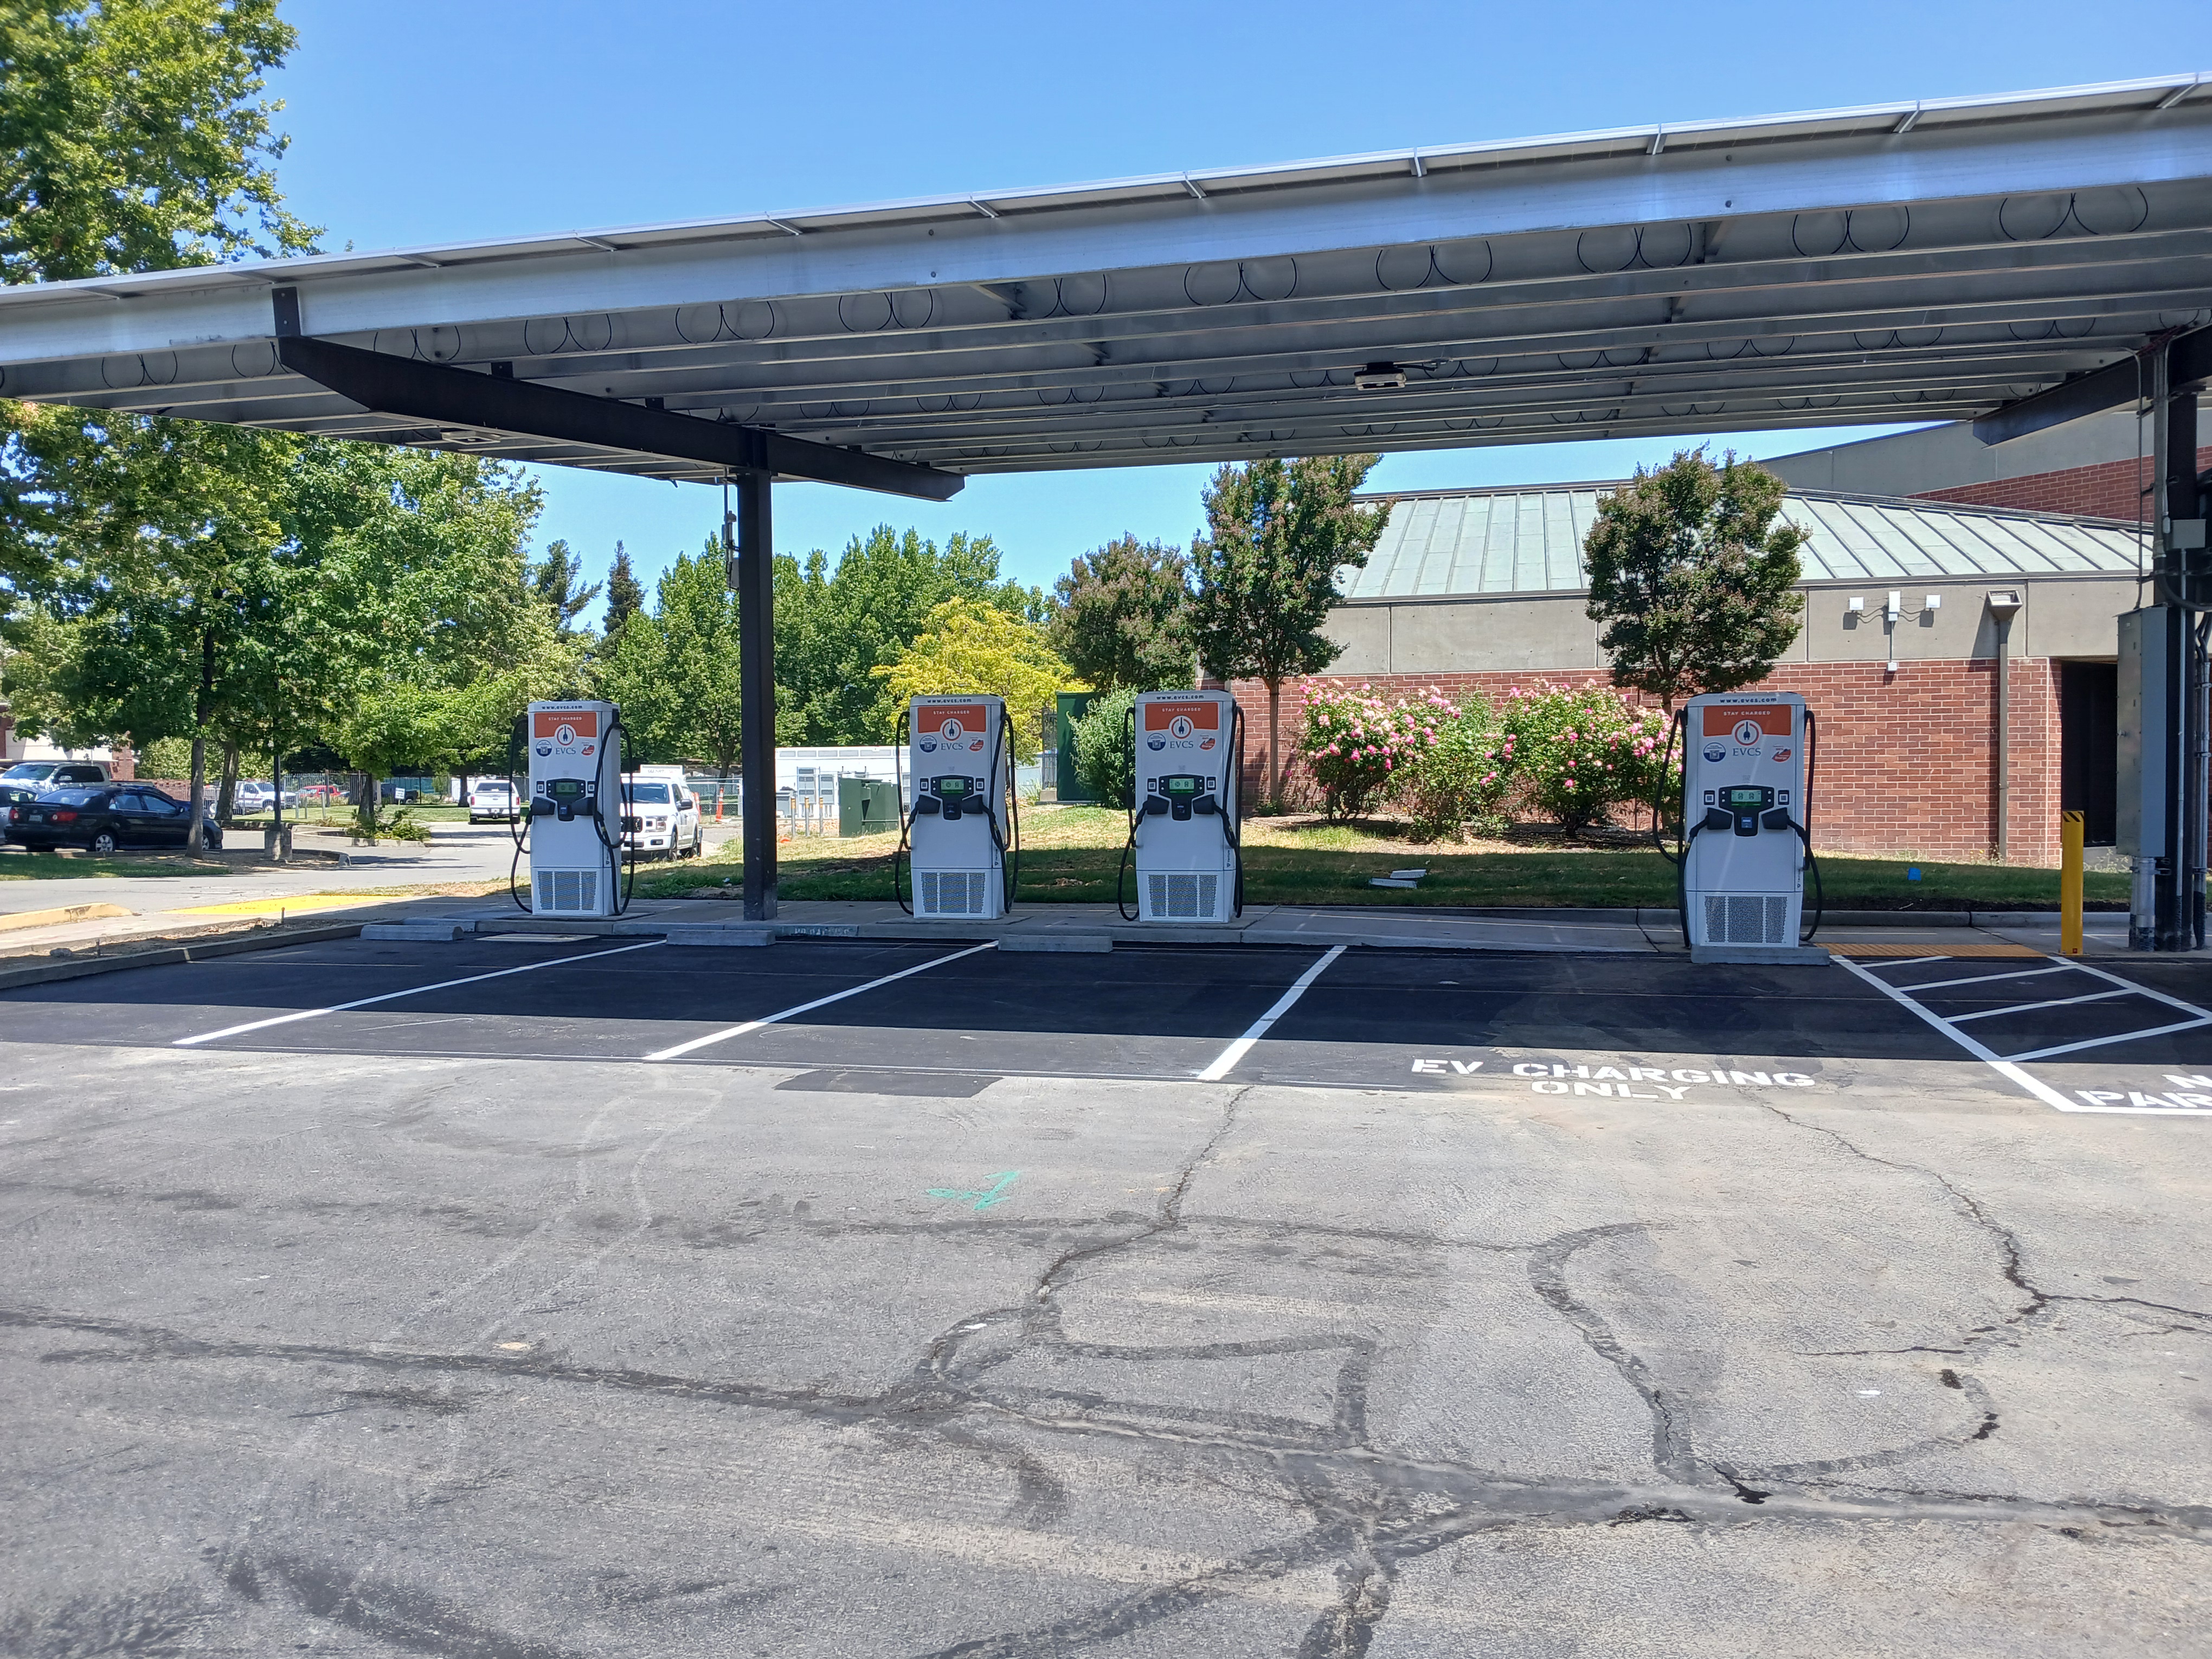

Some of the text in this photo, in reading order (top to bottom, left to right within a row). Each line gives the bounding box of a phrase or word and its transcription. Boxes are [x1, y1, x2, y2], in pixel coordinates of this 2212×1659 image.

[941, 742, 963, 750] EVCS
[1169, 741, 1193, 749] EVCS
[1732, 747, 1761, 757] EVCS
[1411, 1058, 1815, 1087] EV CHARGING
[1531, 1081, 1693, 1101] ONLY
